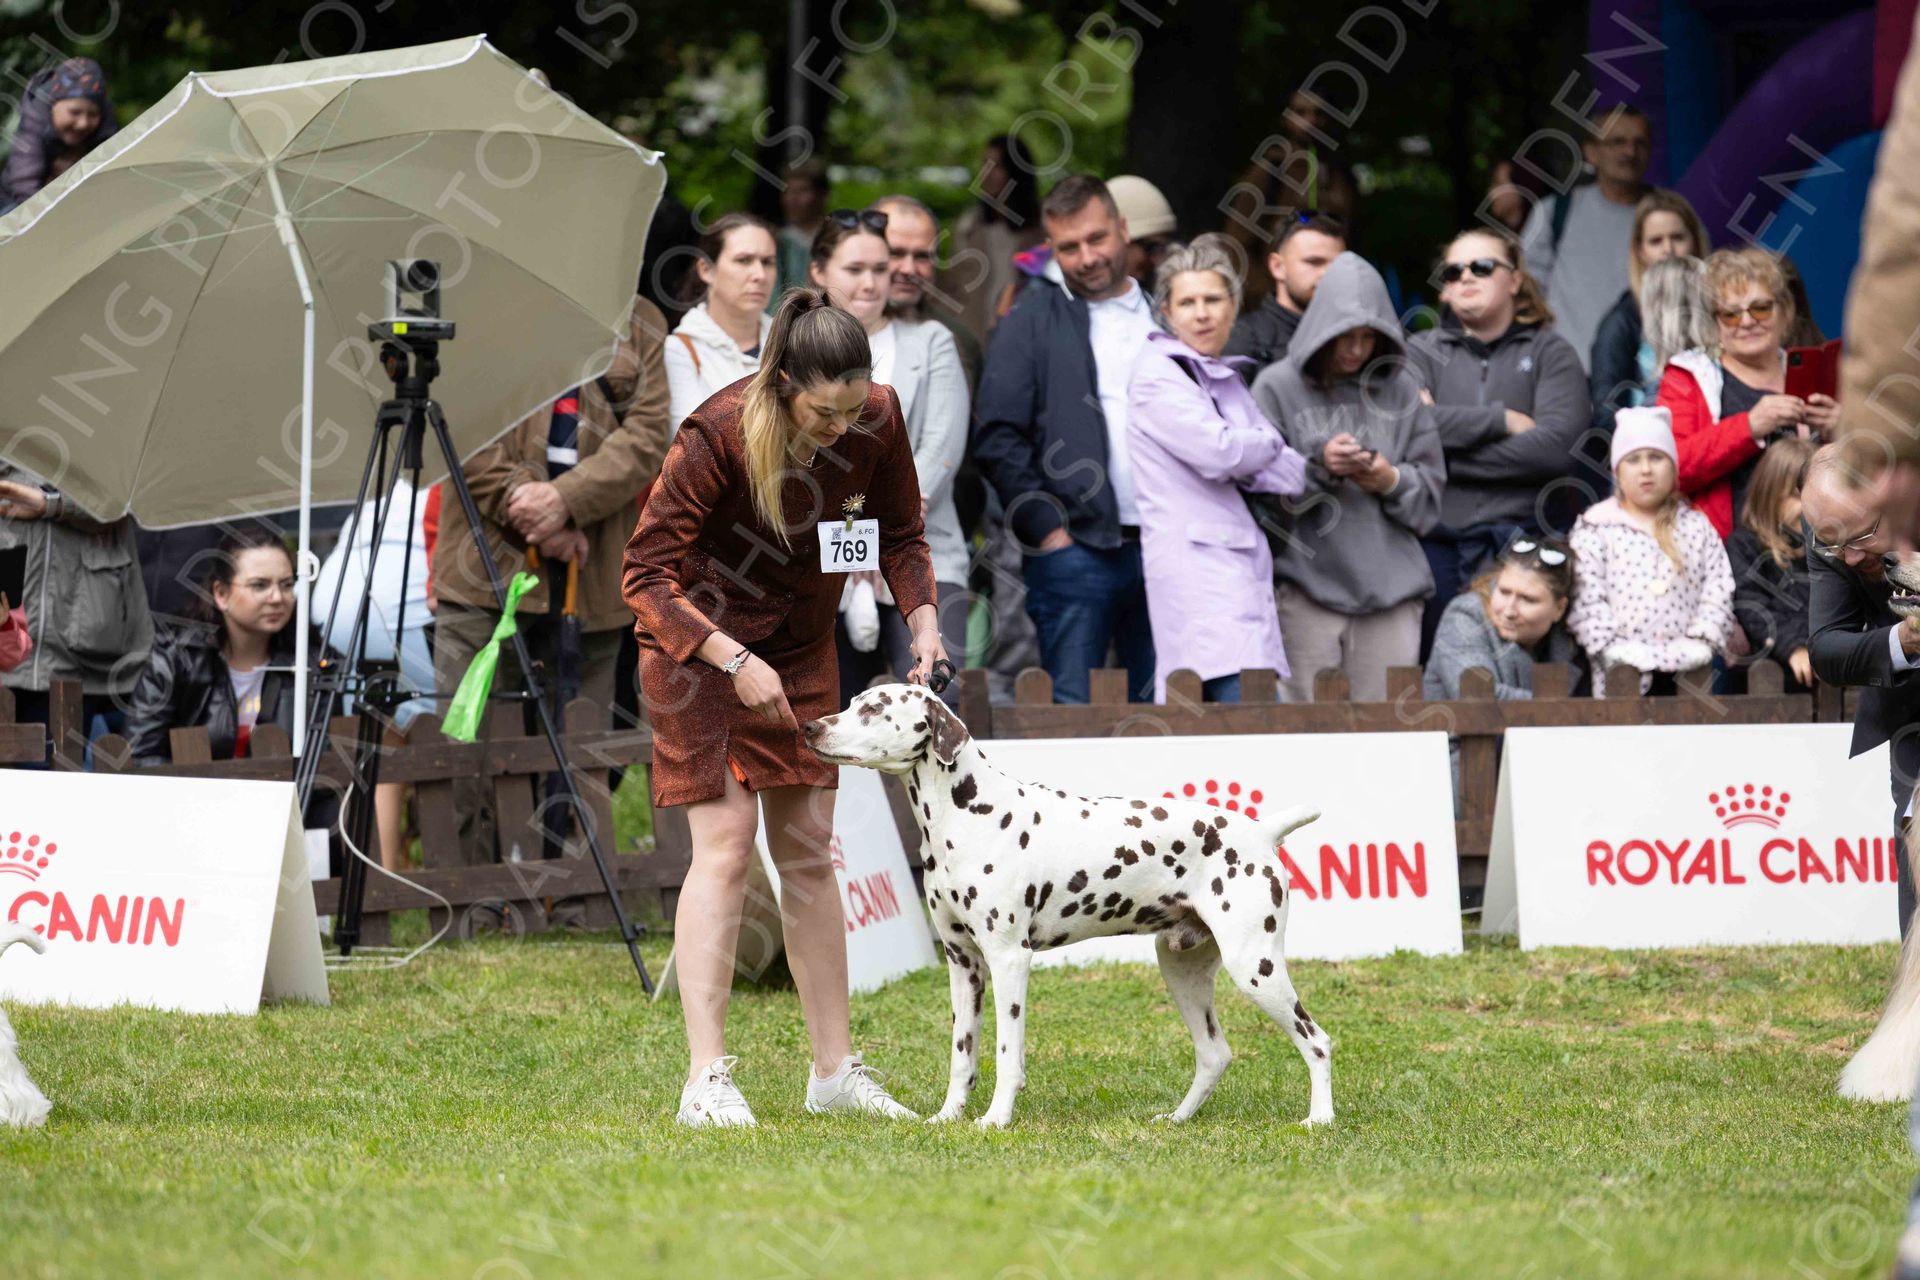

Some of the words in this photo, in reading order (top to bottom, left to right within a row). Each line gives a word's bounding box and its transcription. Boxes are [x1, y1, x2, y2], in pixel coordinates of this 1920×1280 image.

[830, 539, 868, 563] 769
[1276, 841, 1428, 900] ANIN
[1586, 838, 1747, 886] ROYAL
[8, 890, 185, 947] CANIN
